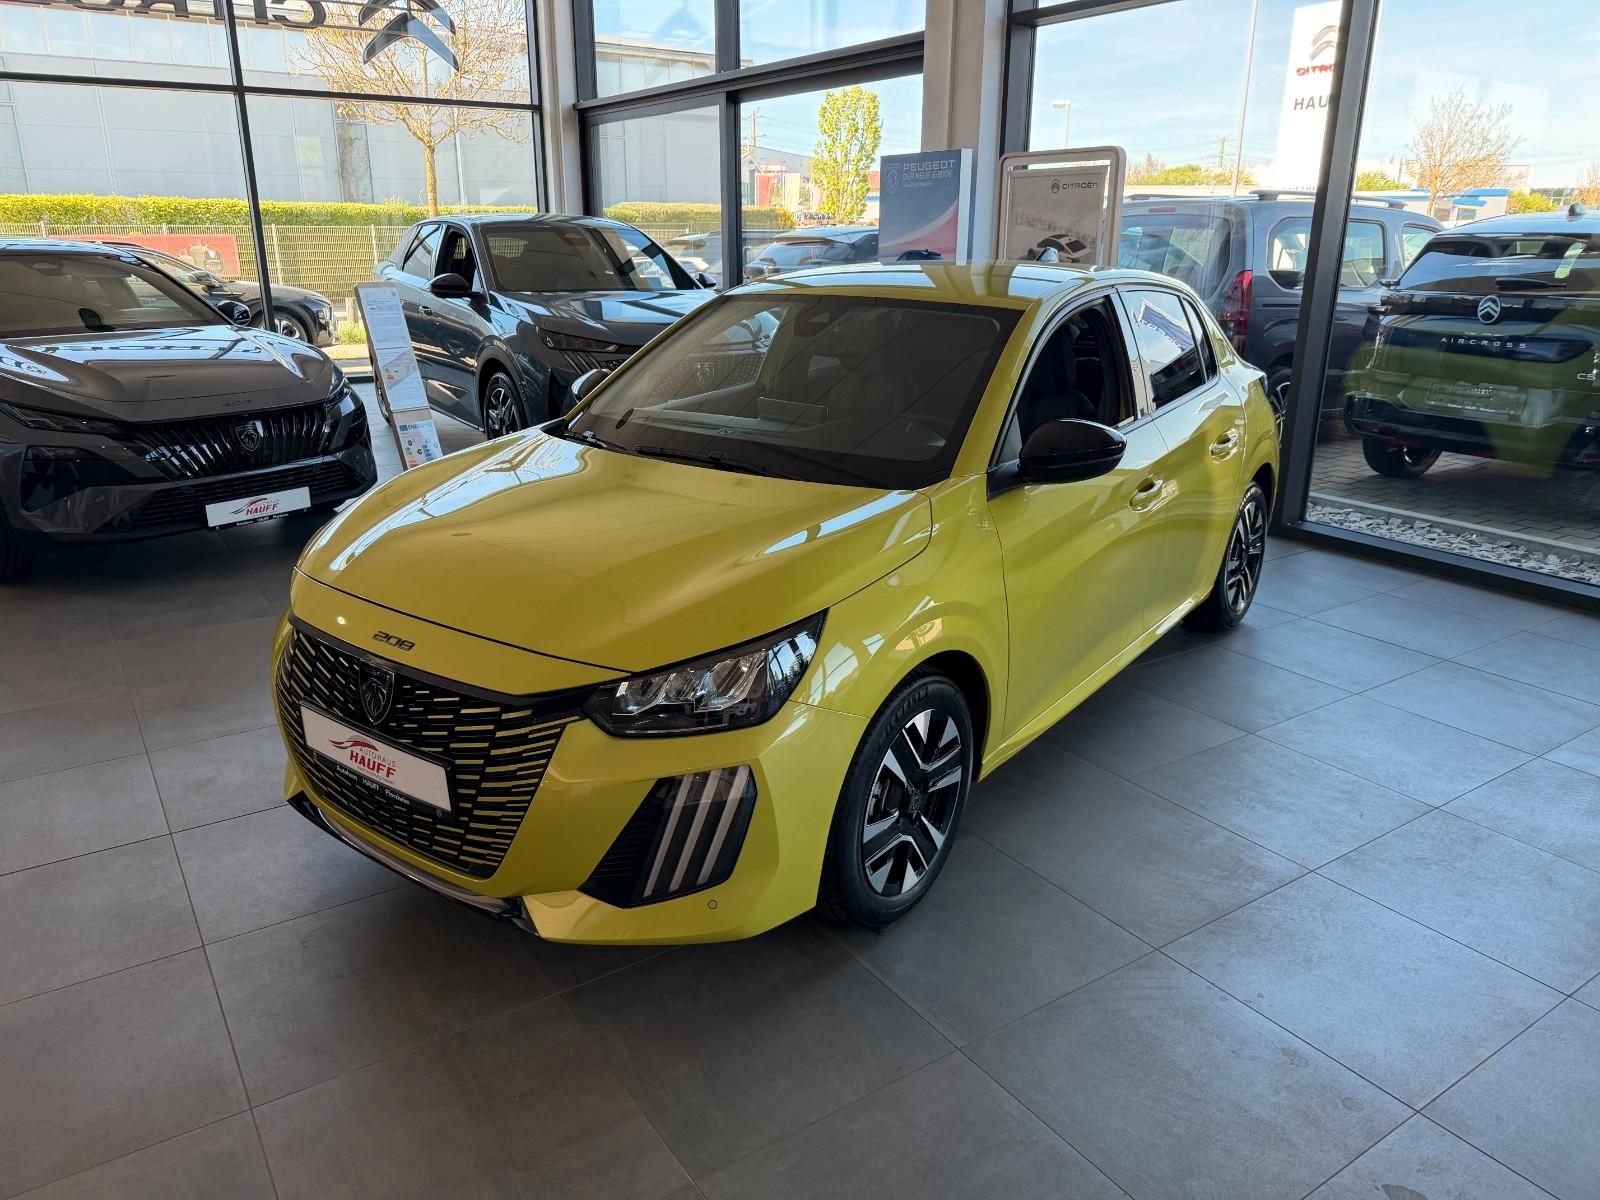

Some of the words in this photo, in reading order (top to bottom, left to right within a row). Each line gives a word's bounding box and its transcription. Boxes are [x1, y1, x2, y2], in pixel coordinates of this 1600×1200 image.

[1293, 95, 1330, 111] HAU
[903, 160, 956, 172] PEUGEOT
[1440, 337, 1527, 349] AIRCROSS
[245, 502, 279, 516] HAUFF
[372, 630, 415, 651] 208
[349, 750, 396, 778] HAUFF
[359, 746, 396, 767] AUTOHAUS
